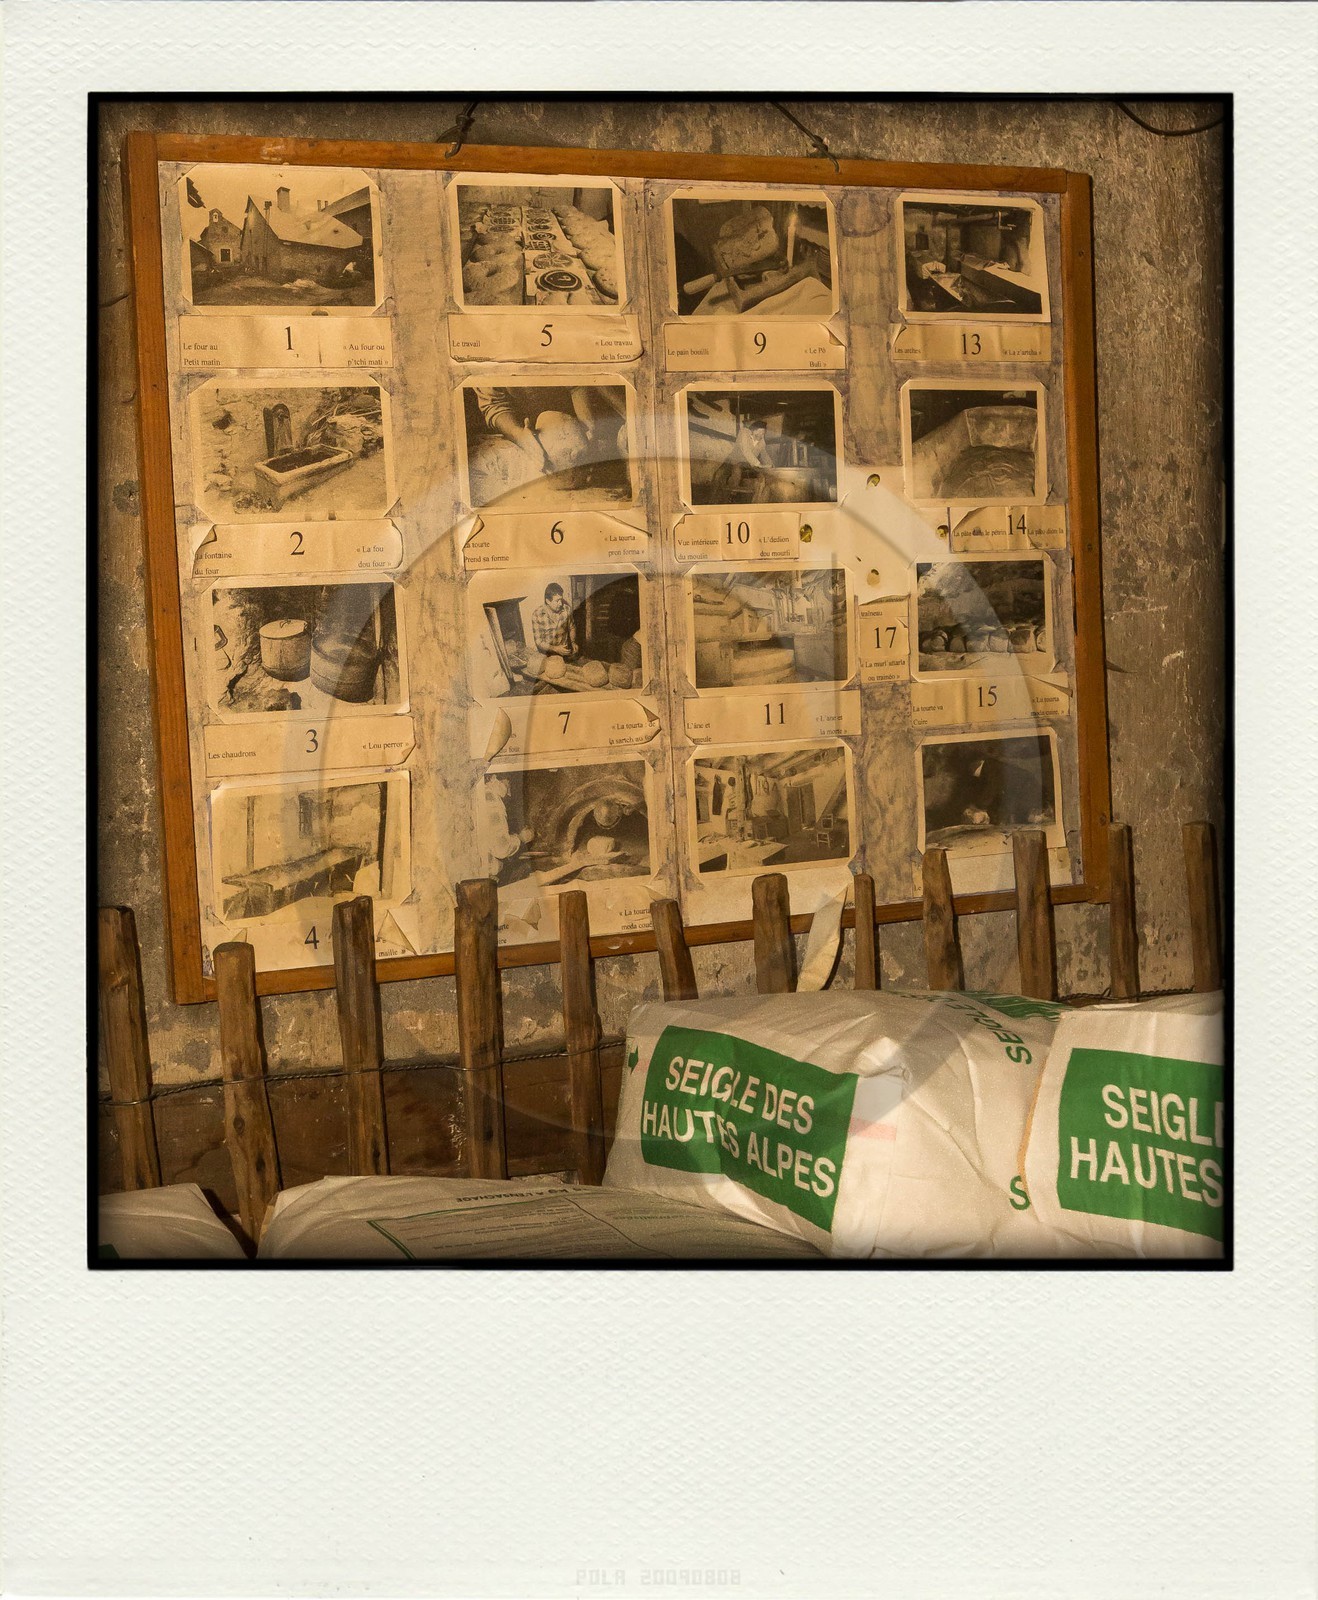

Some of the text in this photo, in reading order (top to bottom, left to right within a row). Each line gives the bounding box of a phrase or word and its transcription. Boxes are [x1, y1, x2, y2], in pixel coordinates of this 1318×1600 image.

[285, 326, 295, 351] 1
[452, 340, 481, 348] Le travail
[540, 324, 554, 347] 5
[753, 332, 767, 355] 9
[962, 334, 982, 355] 13
[184, 358, 200, 366] Petit
[368, 358, 384, 366] mati
[550, 521, 564, 545] 6
[726, 522, 751, 544] 10
[1008, 514, 1027, 535] 14
[290, 531, 305, 556] 2
[373, 545, 384, 553] fou
[204, 551, 232, 560] fontaine
[358, 560, 371, 568] dou
[372, 560, 386, 568] four
[195, 568, 219, 576] du four
[874, 627, 897, 649] 17
[978, 685, 998, 708] 15
[558, 711, 571, 734] 7
[764, 702, 786, 726] 11
[305, 729, 320, 754] 3
[368, 742, 382, 750] Lou
[222, 750, 256, 759] chaudrons
[305, 926, 320, 950] 4
[665, 1056, 760, 1114] SEIGLE
[761, 1083, 815, 1134] DES
[642, 1100, 836, 1198] HAUTES ALPES
[1070, 1136, 1223, 1208] HAUTES
